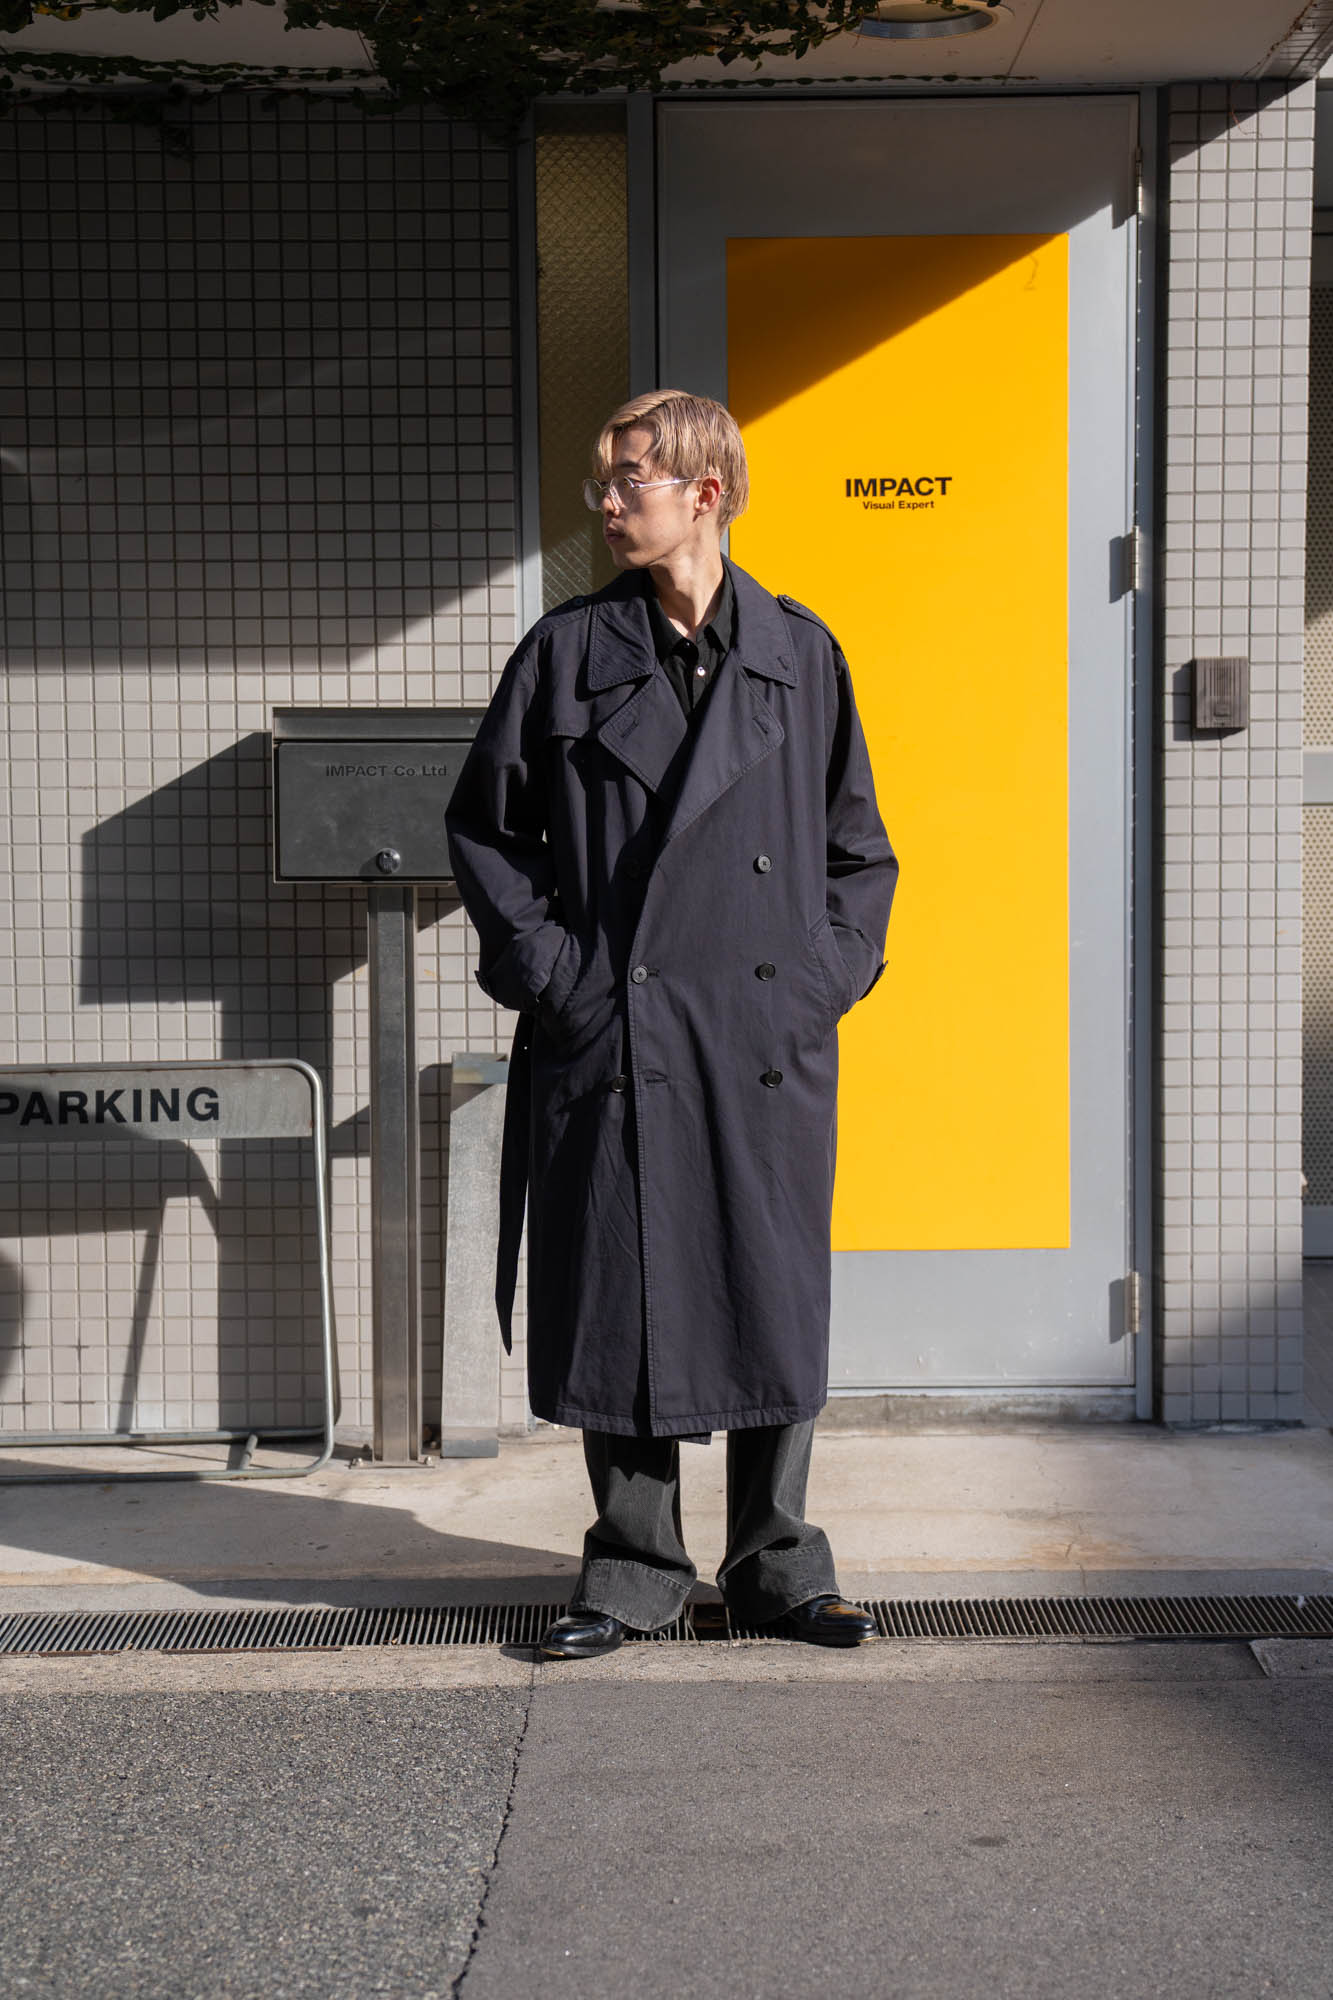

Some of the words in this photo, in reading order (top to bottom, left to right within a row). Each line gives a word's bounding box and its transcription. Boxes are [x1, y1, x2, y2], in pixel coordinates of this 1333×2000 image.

[845, 476, 953, 498] IMPACT
[862, 501, 895, 510] Visual
[898, 500, 935, 510] Expert
[326, 765, 387, 777] IMPACT
[0, 1086, 220, 1126] PARKING
